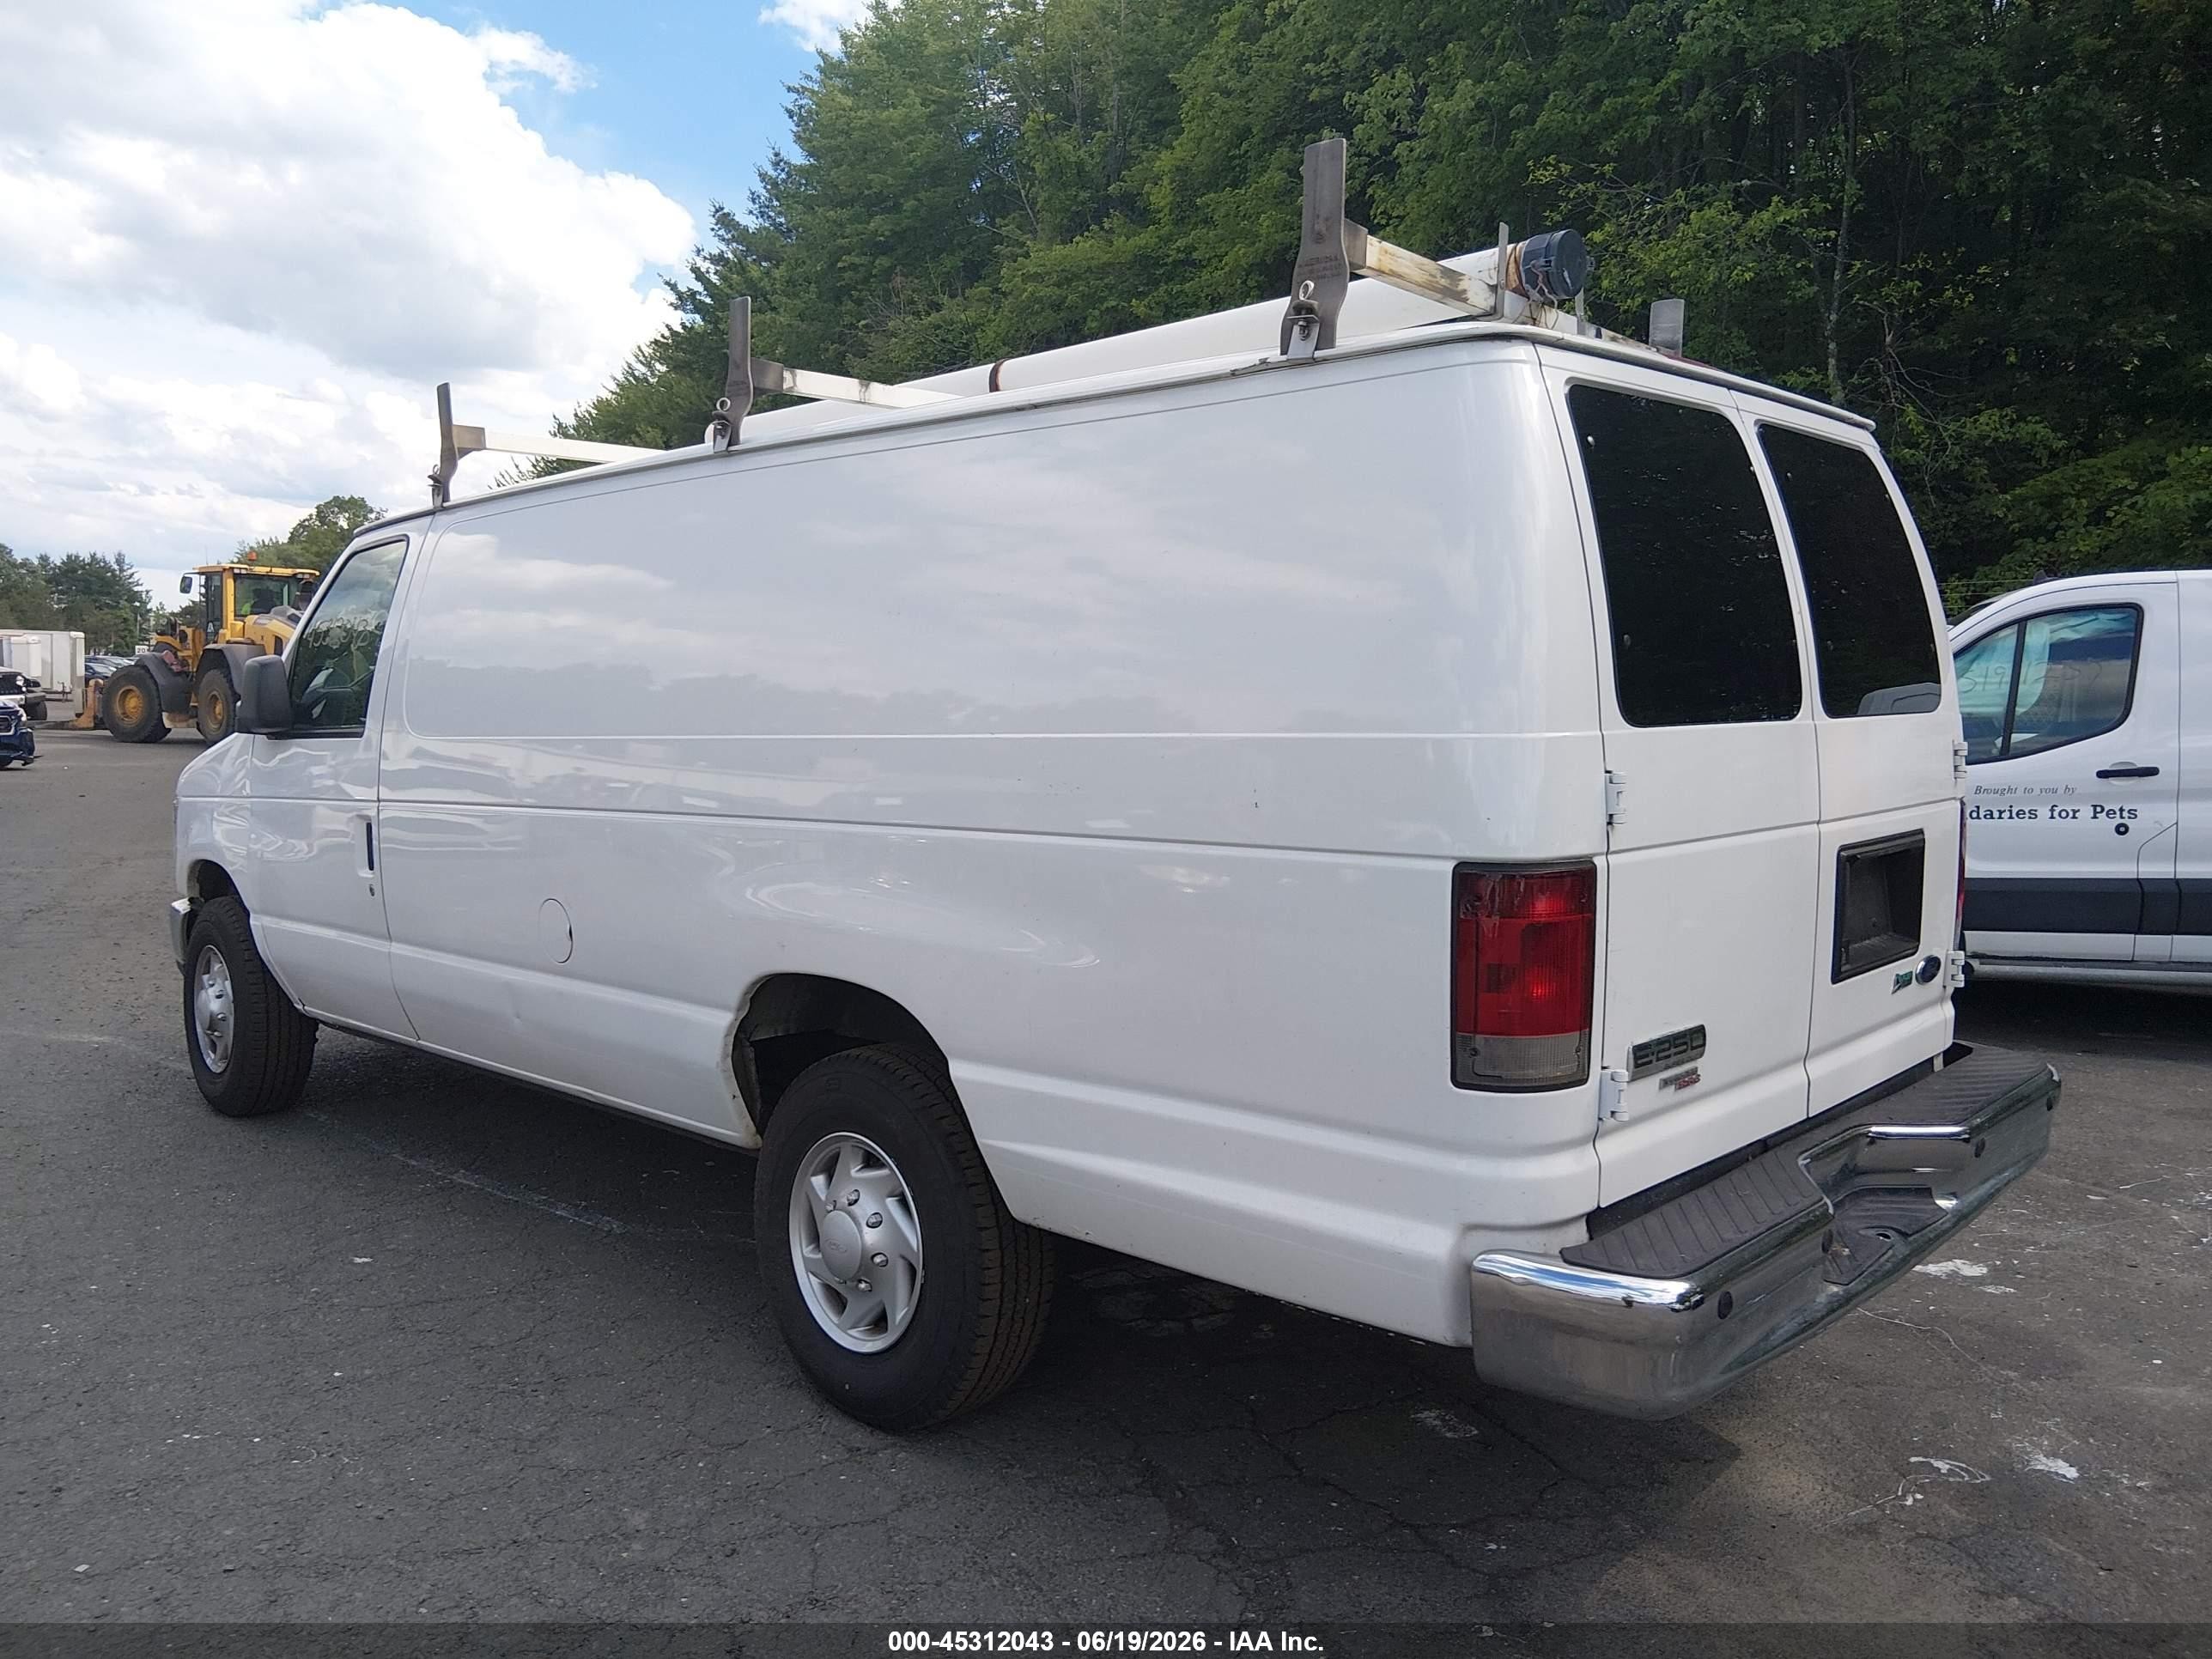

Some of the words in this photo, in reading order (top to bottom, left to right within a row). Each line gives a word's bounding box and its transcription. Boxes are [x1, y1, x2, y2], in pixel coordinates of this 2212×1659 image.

[1973, 785, 2018, 797] Brought
[2023, 786, 2033, 795] to
[2038, 787, 2058, 797] you
[2063, 785, 2078, 796] by
[2048, 804, 2081, 820] for
[2090, 804, 2138, 820] Pets
